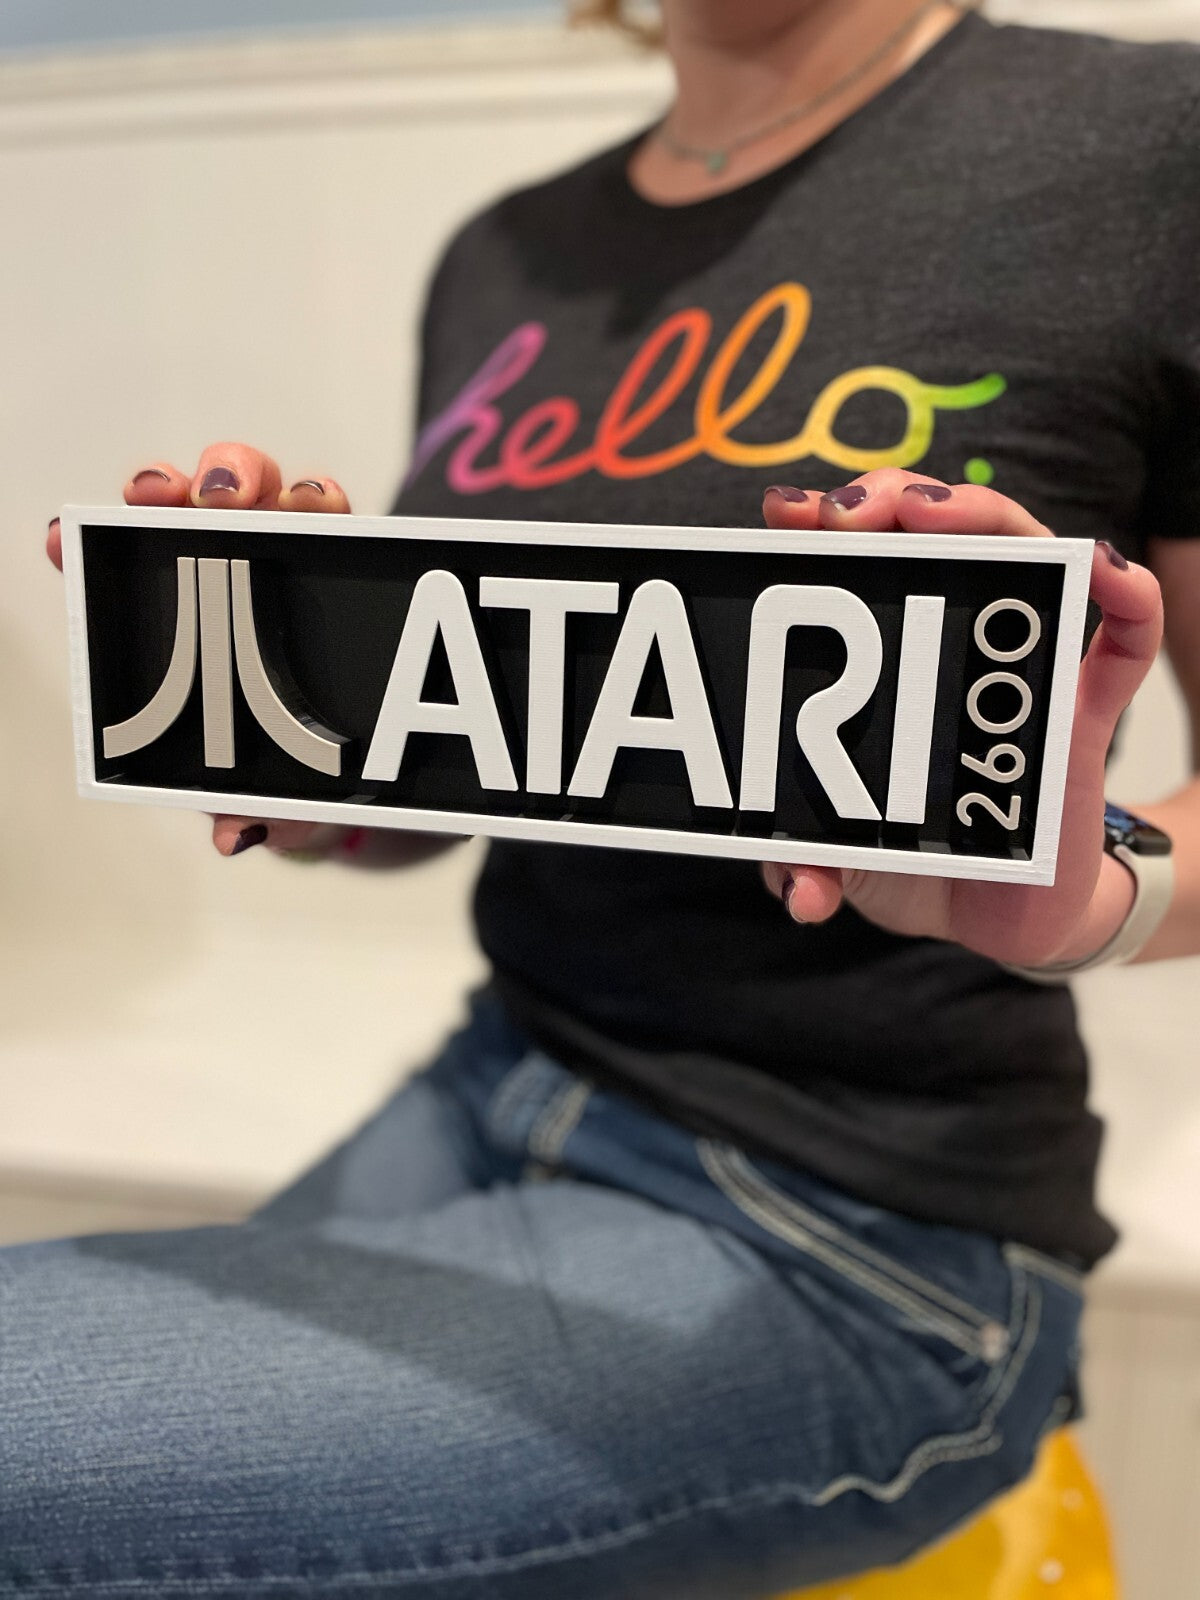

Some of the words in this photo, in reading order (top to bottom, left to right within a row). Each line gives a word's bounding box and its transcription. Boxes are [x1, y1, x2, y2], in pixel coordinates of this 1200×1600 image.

[405, 282, 1006, 494] hello.
[362, 570, 946, 824] ATARI
[956, 598, 1041, 830] 2600
